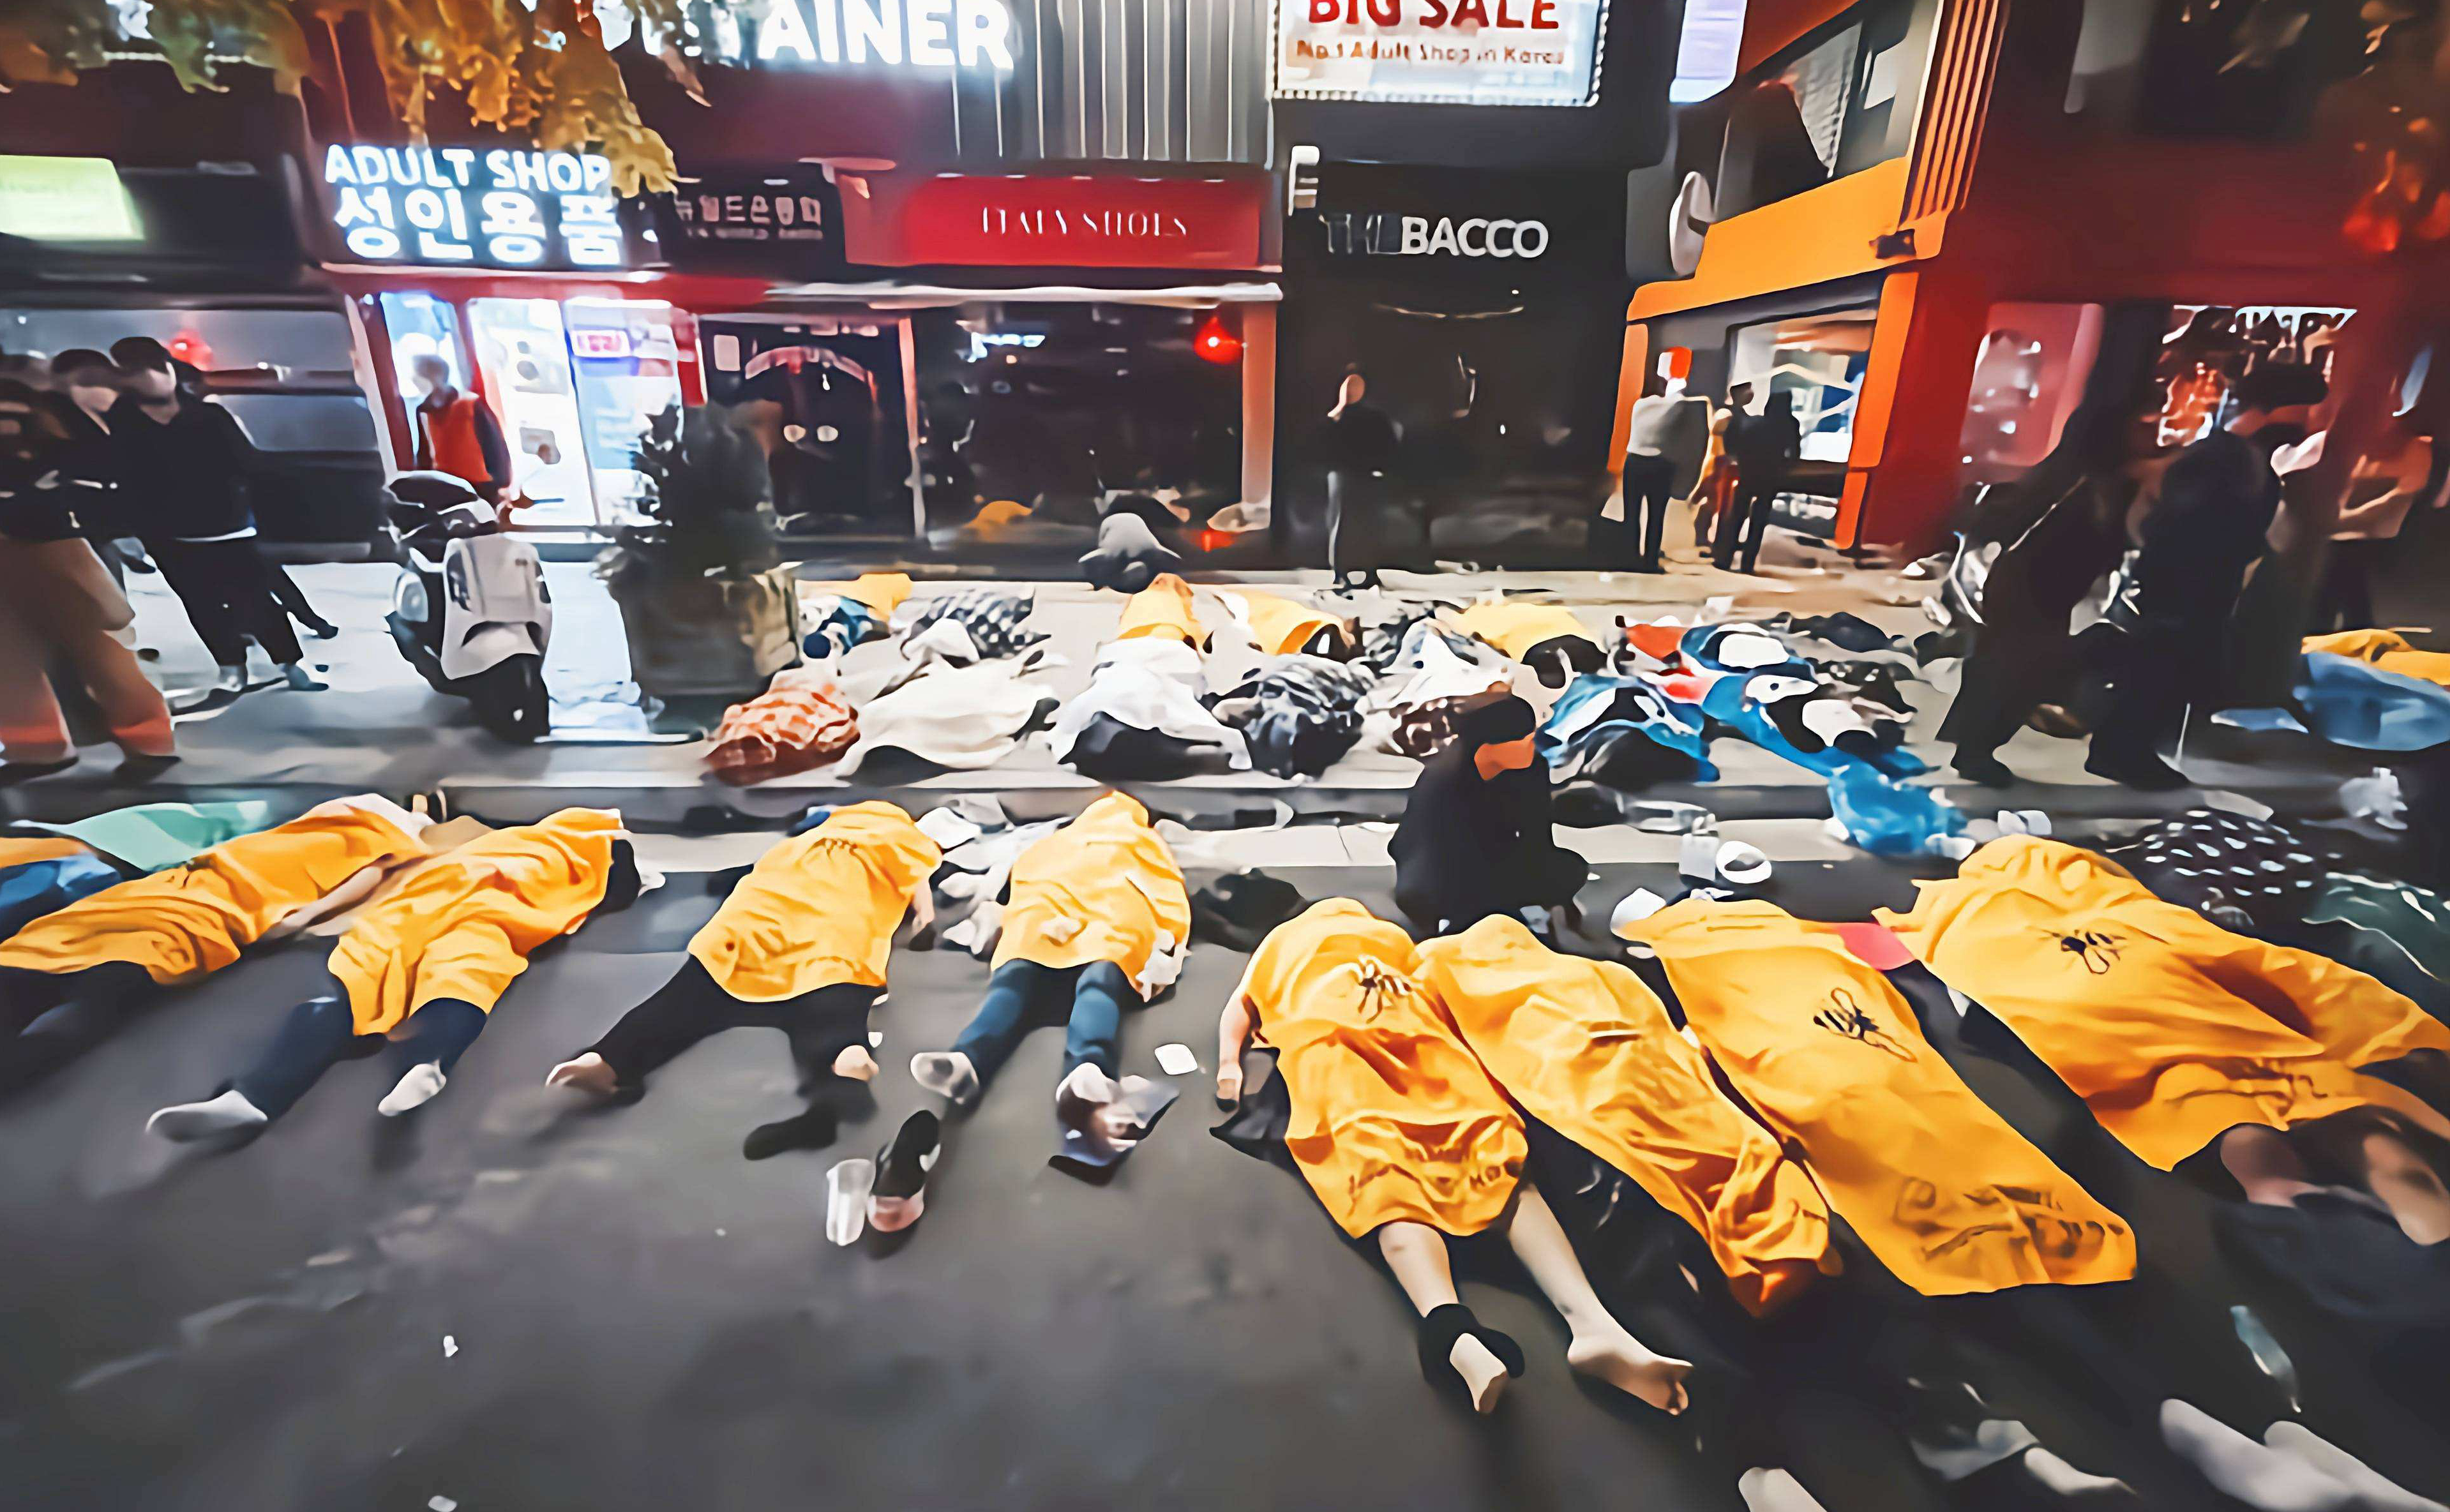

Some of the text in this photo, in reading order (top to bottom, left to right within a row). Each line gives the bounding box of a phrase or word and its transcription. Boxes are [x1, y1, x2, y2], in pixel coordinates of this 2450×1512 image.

[710, 0, 1014, 69] AINER
[1419, 0, 1559, 29] SALE
[325, 144, 612, 191] ADULT SHOP
[333, 186, 623, 266] 성인용품
[1401, 216, 1549, 258] BACCO
